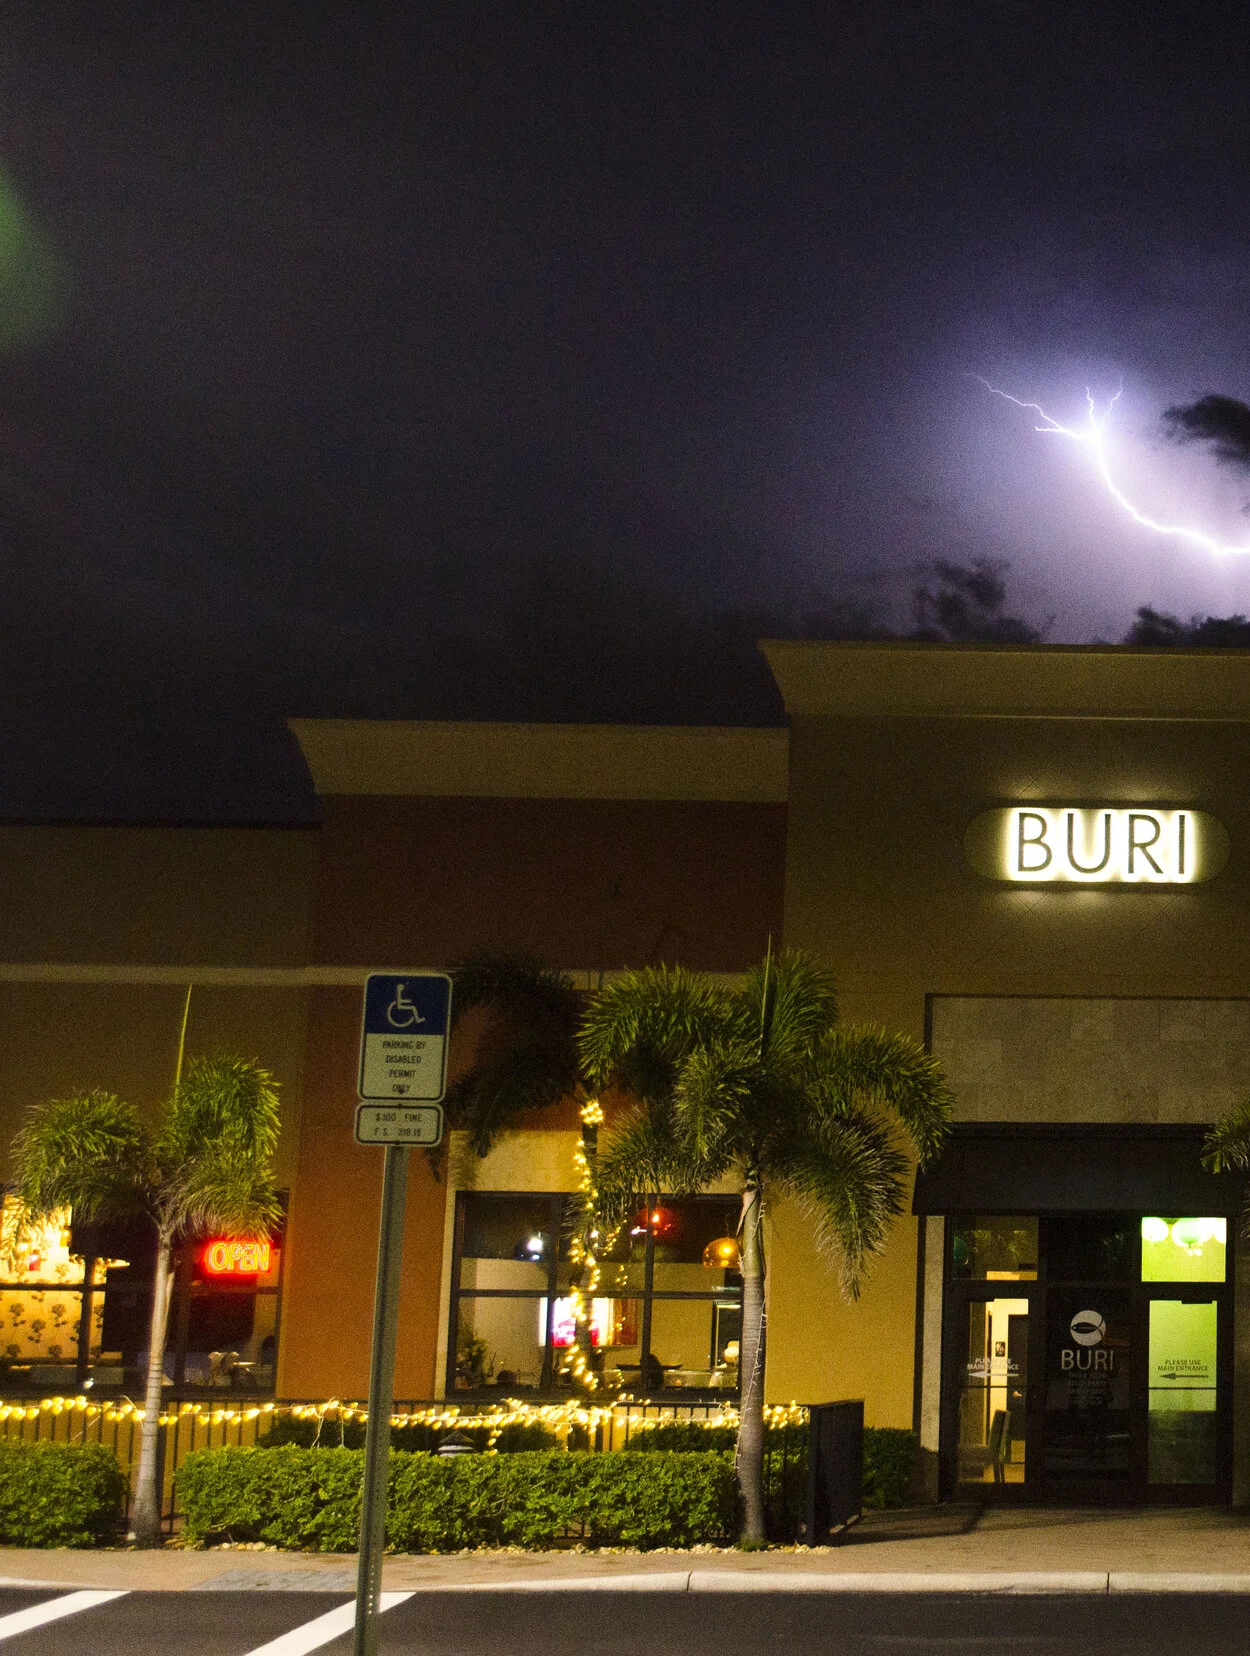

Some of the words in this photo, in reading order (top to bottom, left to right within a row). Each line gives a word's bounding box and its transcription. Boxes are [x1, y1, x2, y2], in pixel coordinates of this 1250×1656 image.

[1017, 811, 1186, 874] BURI
[382, 1041, 414, 1049] PARKING
[416, 1041, 426, 1049] BY
[385, 1055, 422, 1064] DISABLED
[389, 1069, 416, 1078] PERMIT
[404, 1113, 423, 1122] FINE
[209, 1242, 270, 1271] OPEN
[1060, 1349, 1114, 1370] BURI
